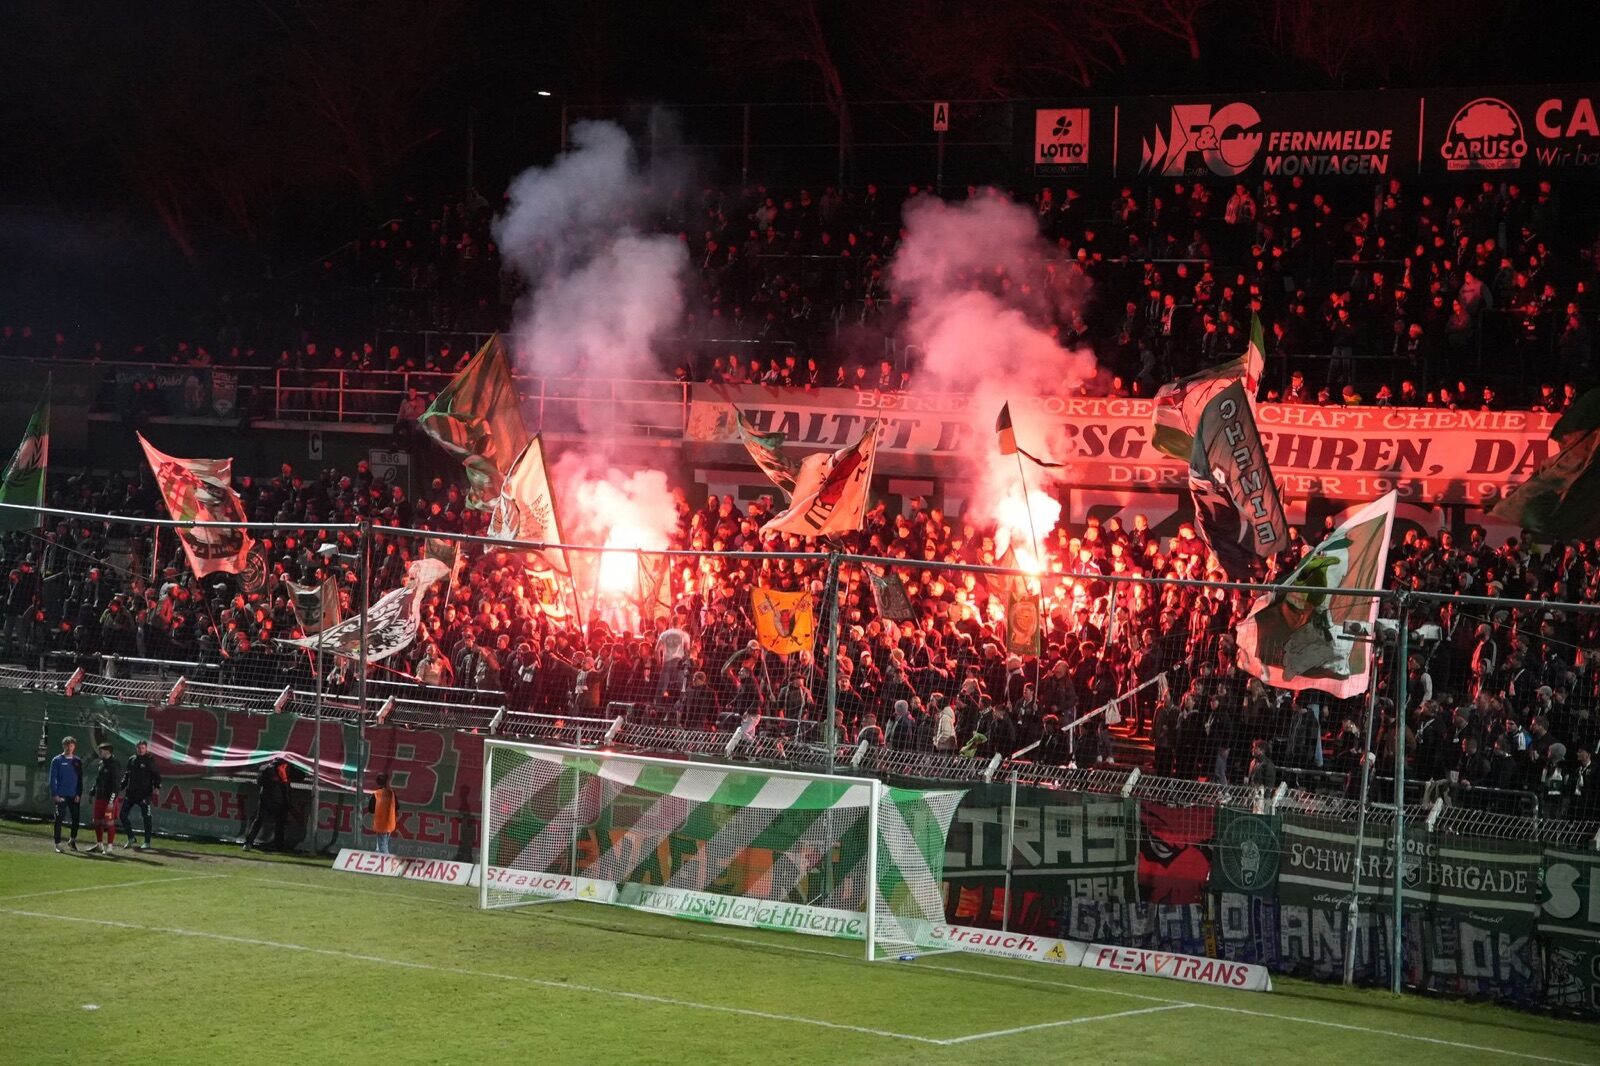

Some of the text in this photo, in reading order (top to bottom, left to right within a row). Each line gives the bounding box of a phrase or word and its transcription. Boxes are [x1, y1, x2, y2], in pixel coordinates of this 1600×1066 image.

[1041, 144, 1083, 158] LOTTO
[1267, 130, 1392, 152] FERNMELDE
[1440, 139, 1527, 160] CARUSO
[1262, 154, 1389, 176] MONTAGEN
[1536, 147, 1570, 167] Wir
[1383, 411, 1525, 430] CHEMIE
[311, 433, 320, 453] C
[380, 454, 400, 464] BSG
[1427, 862, 1528, 894] BRIGADE
[1066, 875, 1126, 903] 1964
